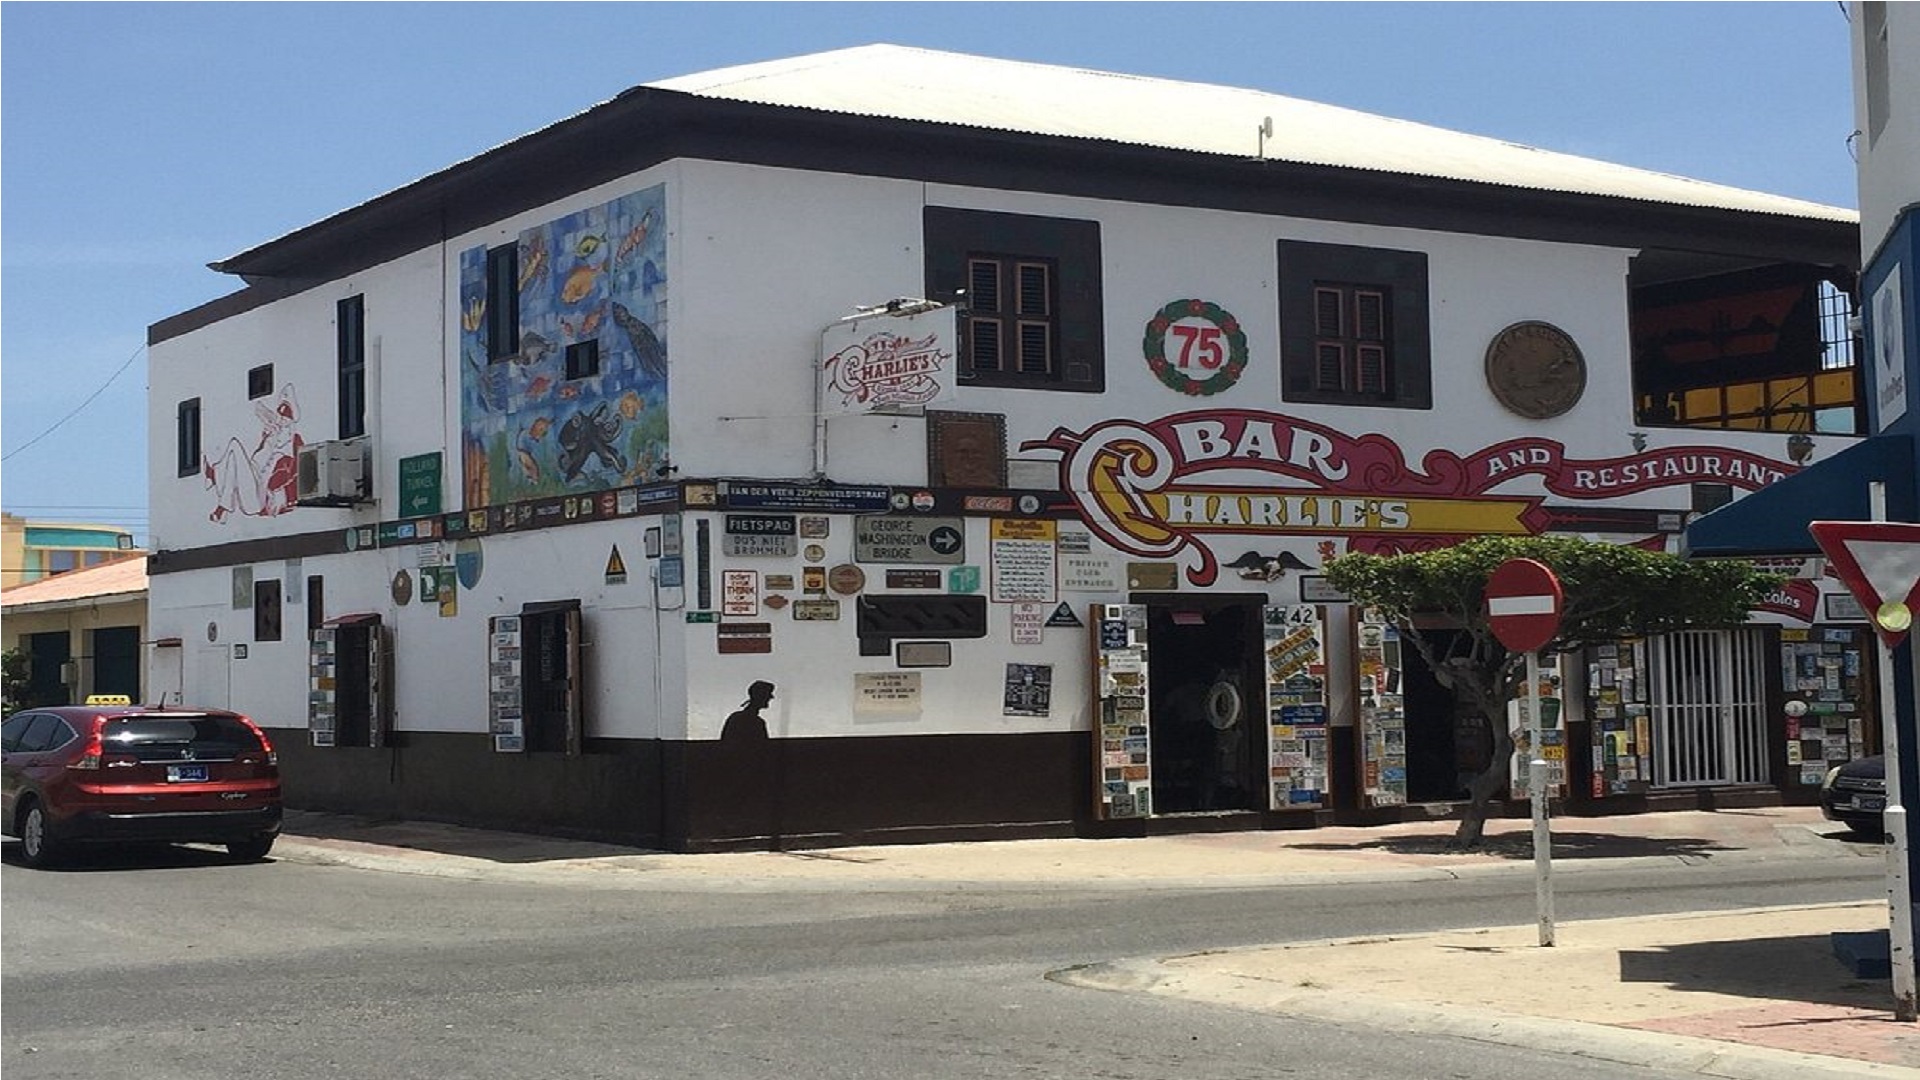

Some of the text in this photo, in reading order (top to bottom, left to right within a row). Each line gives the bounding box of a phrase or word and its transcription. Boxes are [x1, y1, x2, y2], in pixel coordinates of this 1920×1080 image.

[1172, 325, 1224, 370] 75
[831, 344, 930, 403] CHARLIE'S
[1170, 418, 1348, 482] BAR
[1487, 446, 1552, 478] AND
[1574, 455, 1787, 490] RESTAURANT
[1066, 420, 1412, 554] CHARLIE'S
[728, 519, 792, 531] FIETSPAD
[870, 520, 914, 532] GEORGE
[761, 535, 787, 546] NIET
[858, 533, 927, 546] WASHINGTON
[733, 546, 787, 555] BROMMEN
[872, 547, 912, 559] BRIDGE
[1290, 608, 1313, 624] 42
